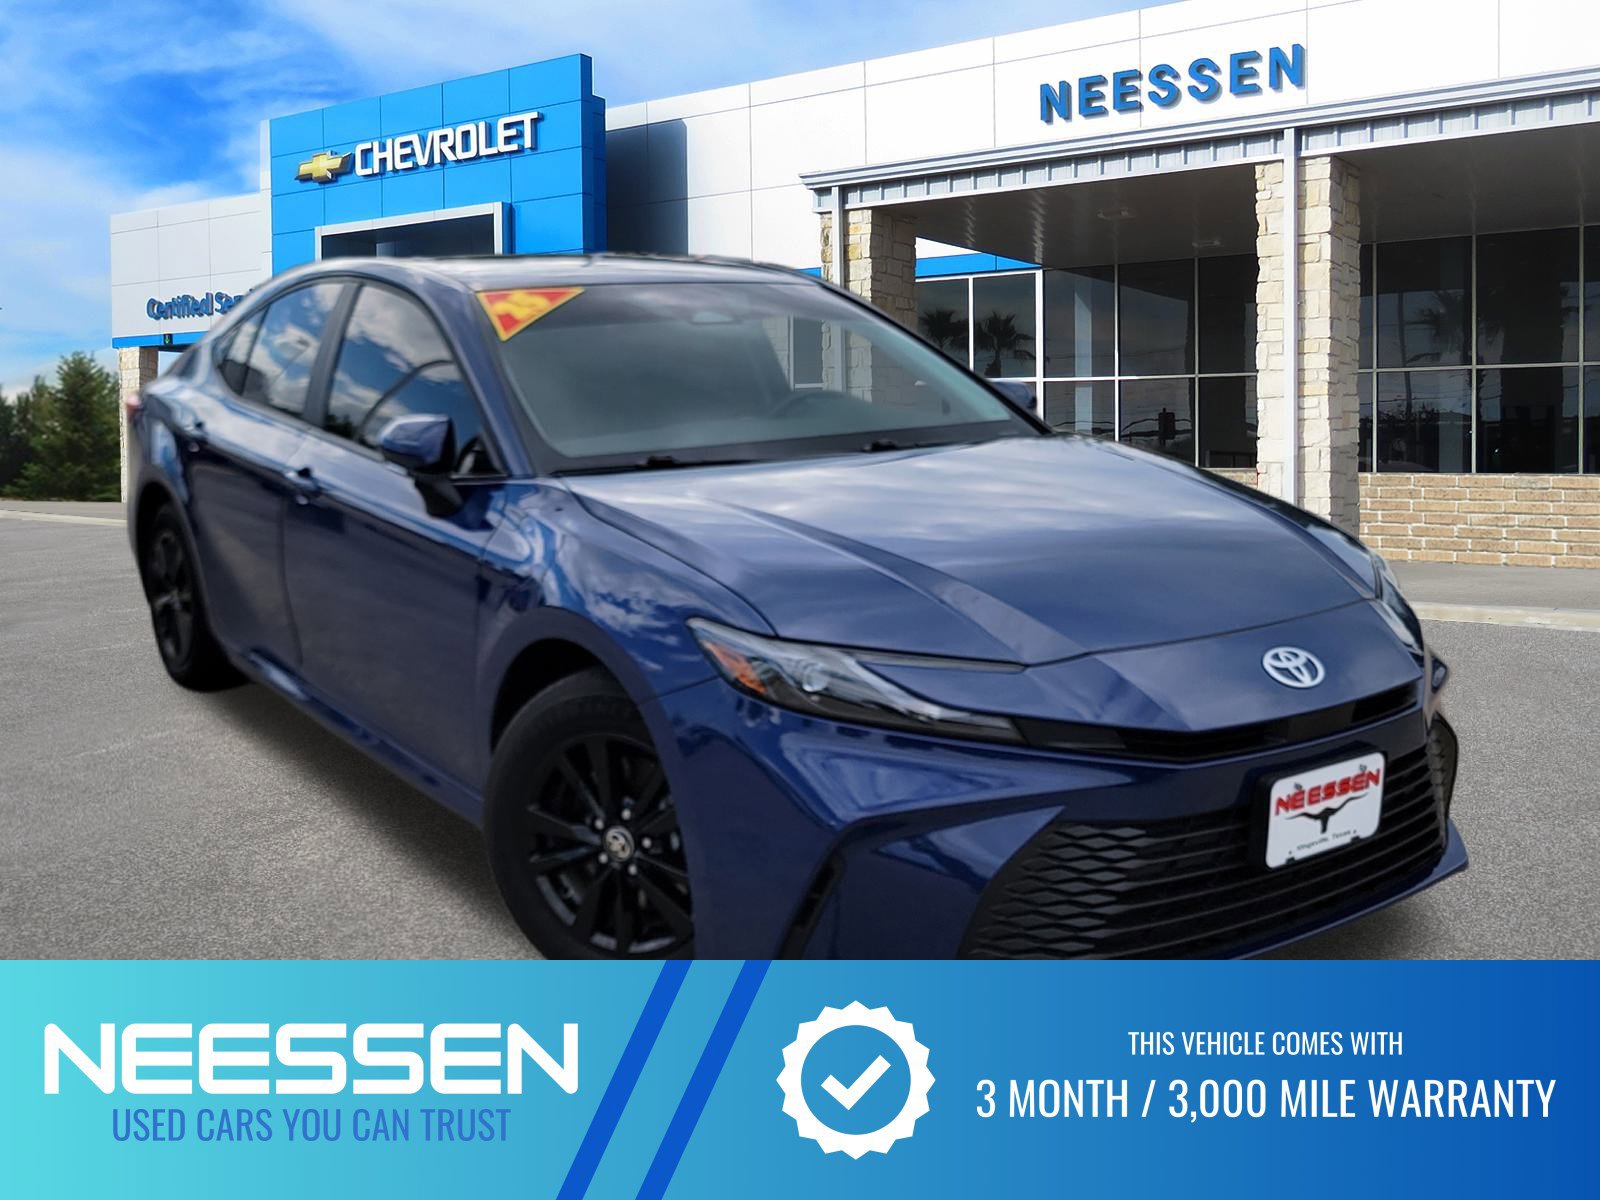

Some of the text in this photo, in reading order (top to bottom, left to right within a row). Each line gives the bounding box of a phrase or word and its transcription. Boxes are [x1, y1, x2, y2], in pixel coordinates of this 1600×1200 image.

[1040, 44, 1306, 123] NEESSEN
[354, 112, 541, 177] CHEVROLET
[147, 292, 213, 320] Certified
[1275, 769, 1381, 816] NEESSEN
